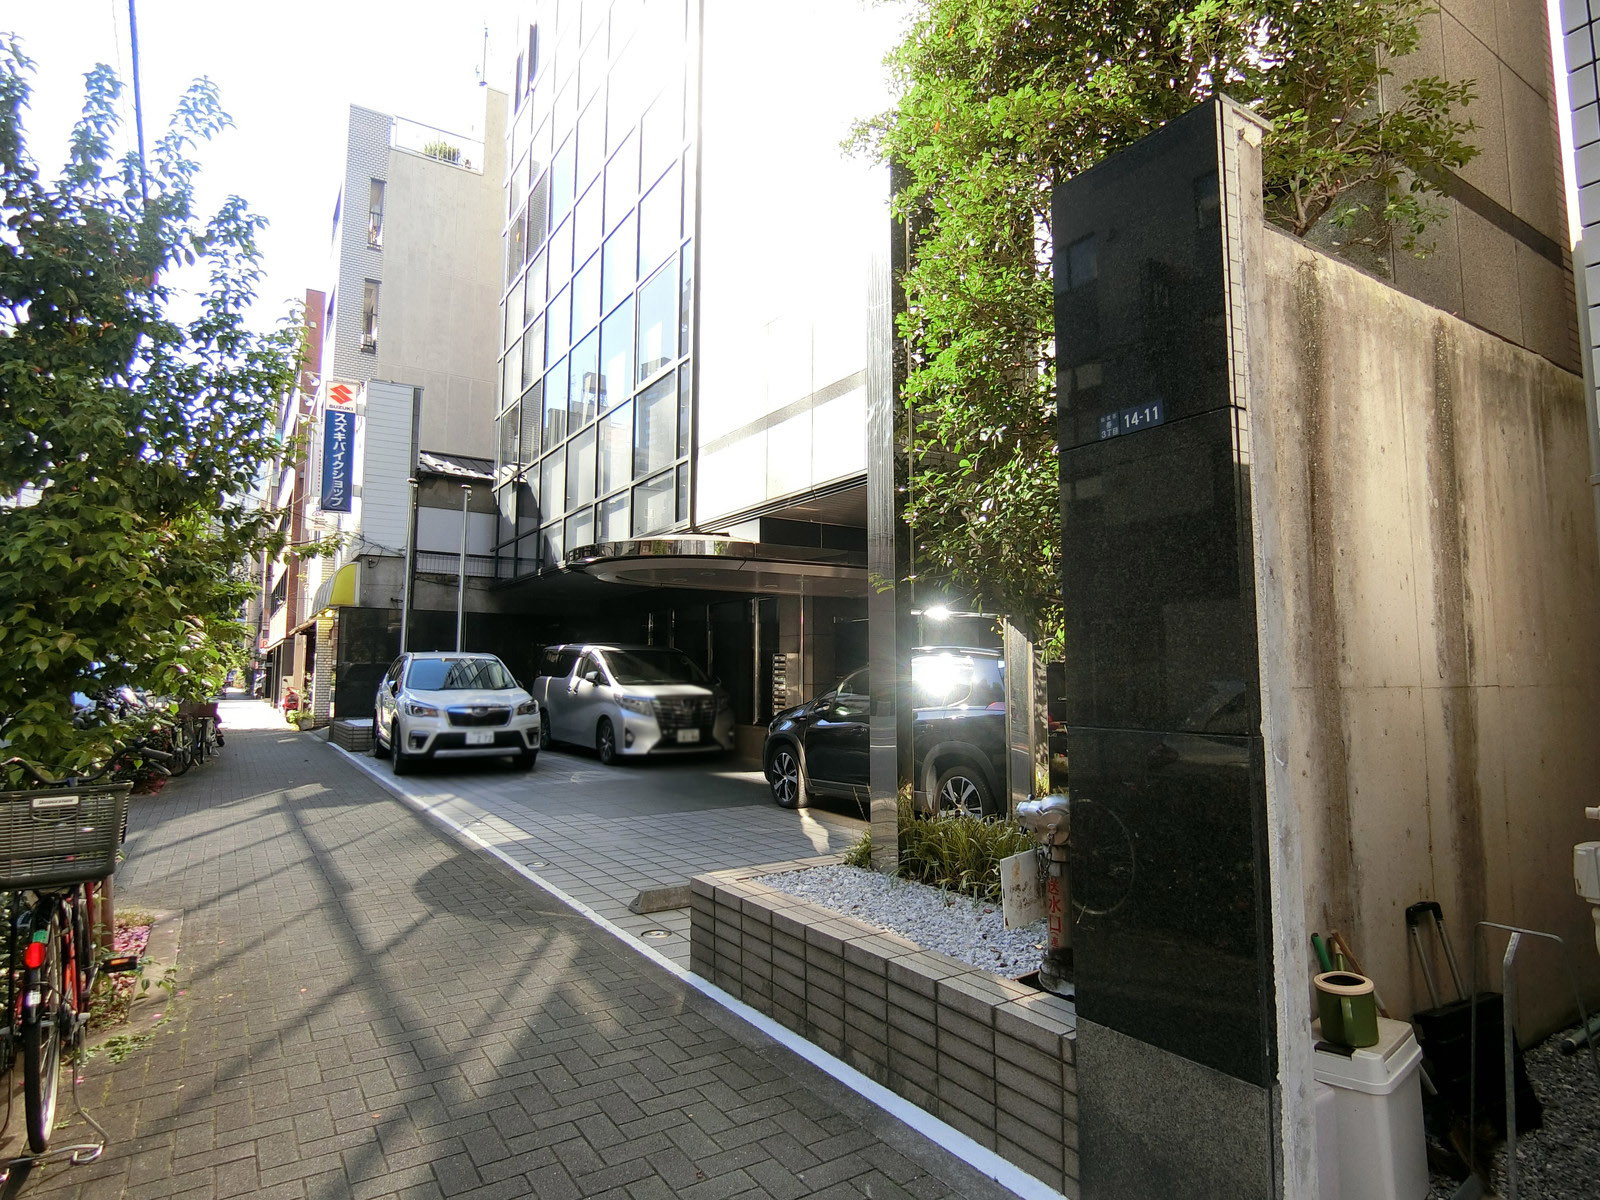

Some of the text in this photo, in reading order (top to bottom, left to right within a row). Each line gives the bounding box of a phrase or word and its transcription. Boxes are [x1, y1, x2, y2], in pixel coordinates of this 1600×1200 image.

[1124, 406, 1159, 428] 14-11
[1101, 426, 1119, 438] 3丁目
[331, 412, 347, 507] スズキバイクショップ
